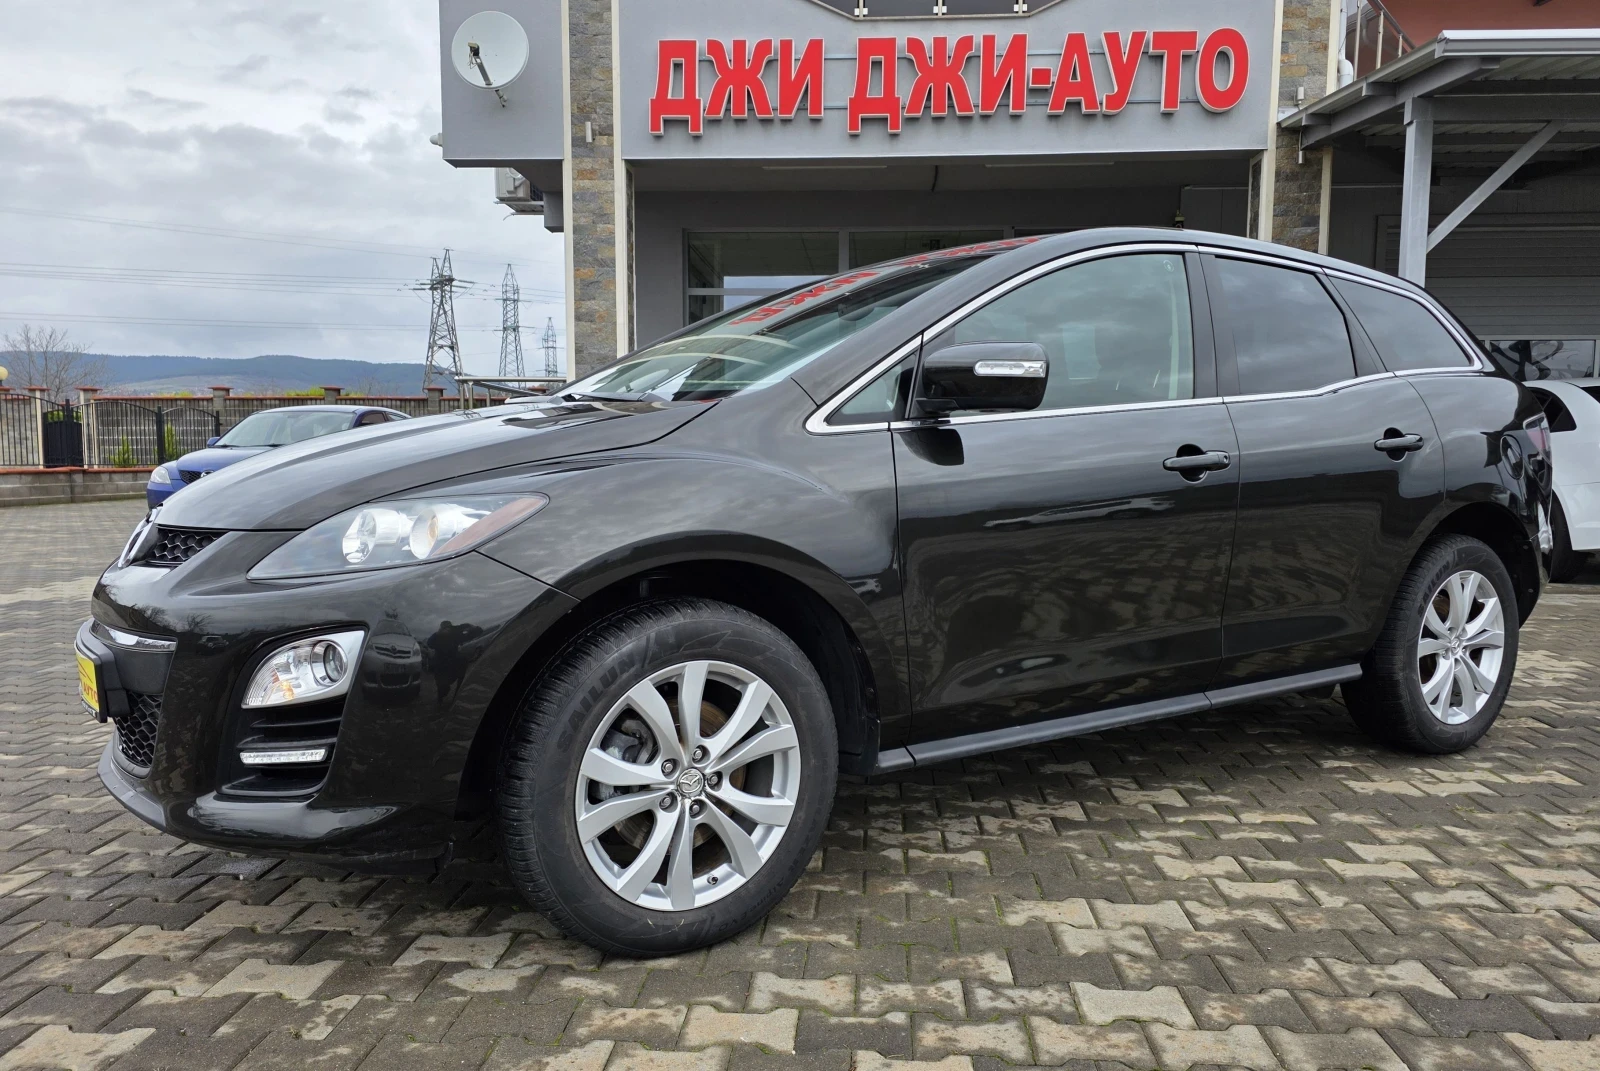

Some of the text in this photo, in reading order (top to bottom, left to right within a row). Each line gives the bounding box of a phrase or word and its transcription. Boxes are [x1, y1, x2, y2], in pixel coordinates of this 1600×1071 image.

[650, 28, 1249, 135] ДЖИ ДЖИ-АУТО
[556, 650, 639, 754] SAILUN
